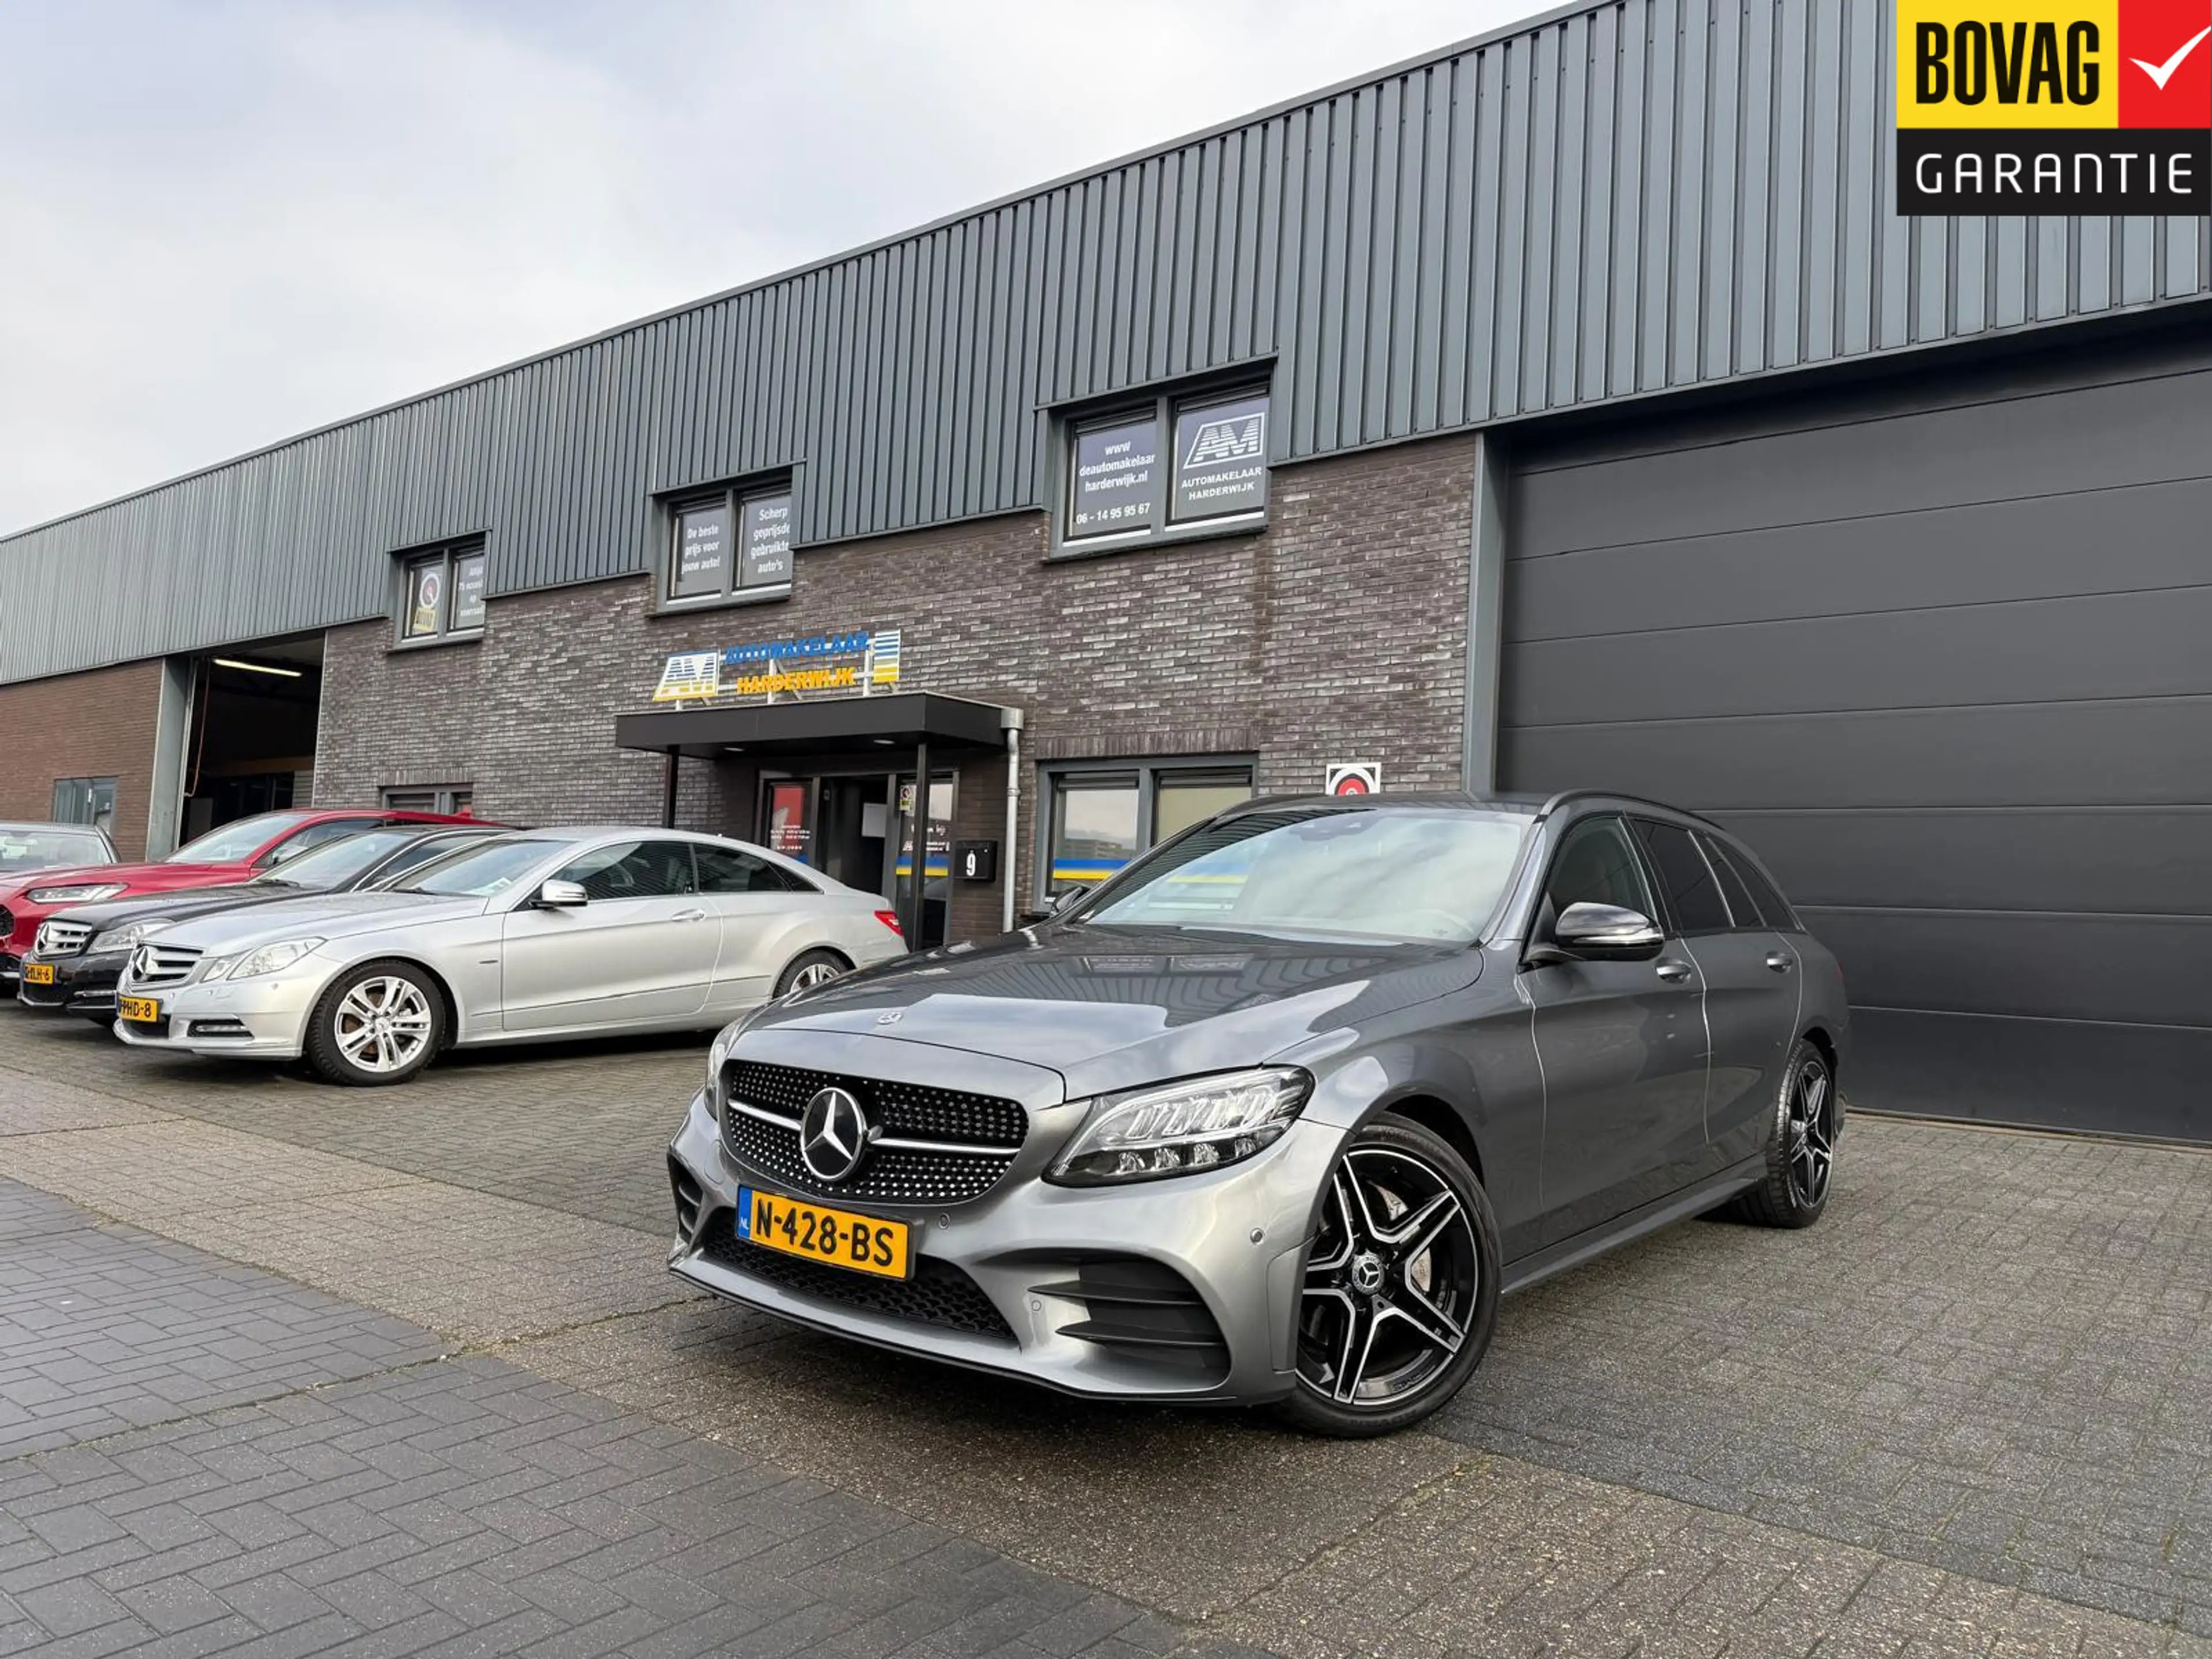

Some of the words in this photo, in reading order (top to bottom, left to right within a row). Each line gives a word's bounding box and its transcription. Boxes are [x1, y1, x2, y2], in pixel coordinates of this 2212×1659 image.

[1105, 440, 1131, 456] www
[1080, 454, 1156, 476] deautomakelaar
[1085, 469, 1147, 493] harderwijk.nl
[1181, 467, 1262, 488] AUTOMAKELAAR
[1188, 482, 1255, 500] HARDERWIJK
[759, 507, 787, 521] Scherp
[1076, 512, 1088, 525] 06
[1097, 509, 1108, 521] 14
[1109, 507, 1122, 519] 95
[1124, 504, 1136, 517] 95
[687, 528, 697, 539] De
[698, 523, 719, 537] beste
[684, 543, 701, 559] prijs
[703, 541, 719, 552] voor
[757, 559, 783, 573] auto's
[725, 631, 869, 665] AUTOMAKELAAR
[737, 666, 856, 695] HARDERWIJK
[966, 853, 976, 876] 9
[756, 1198, 894, 1267] N-428-BS
